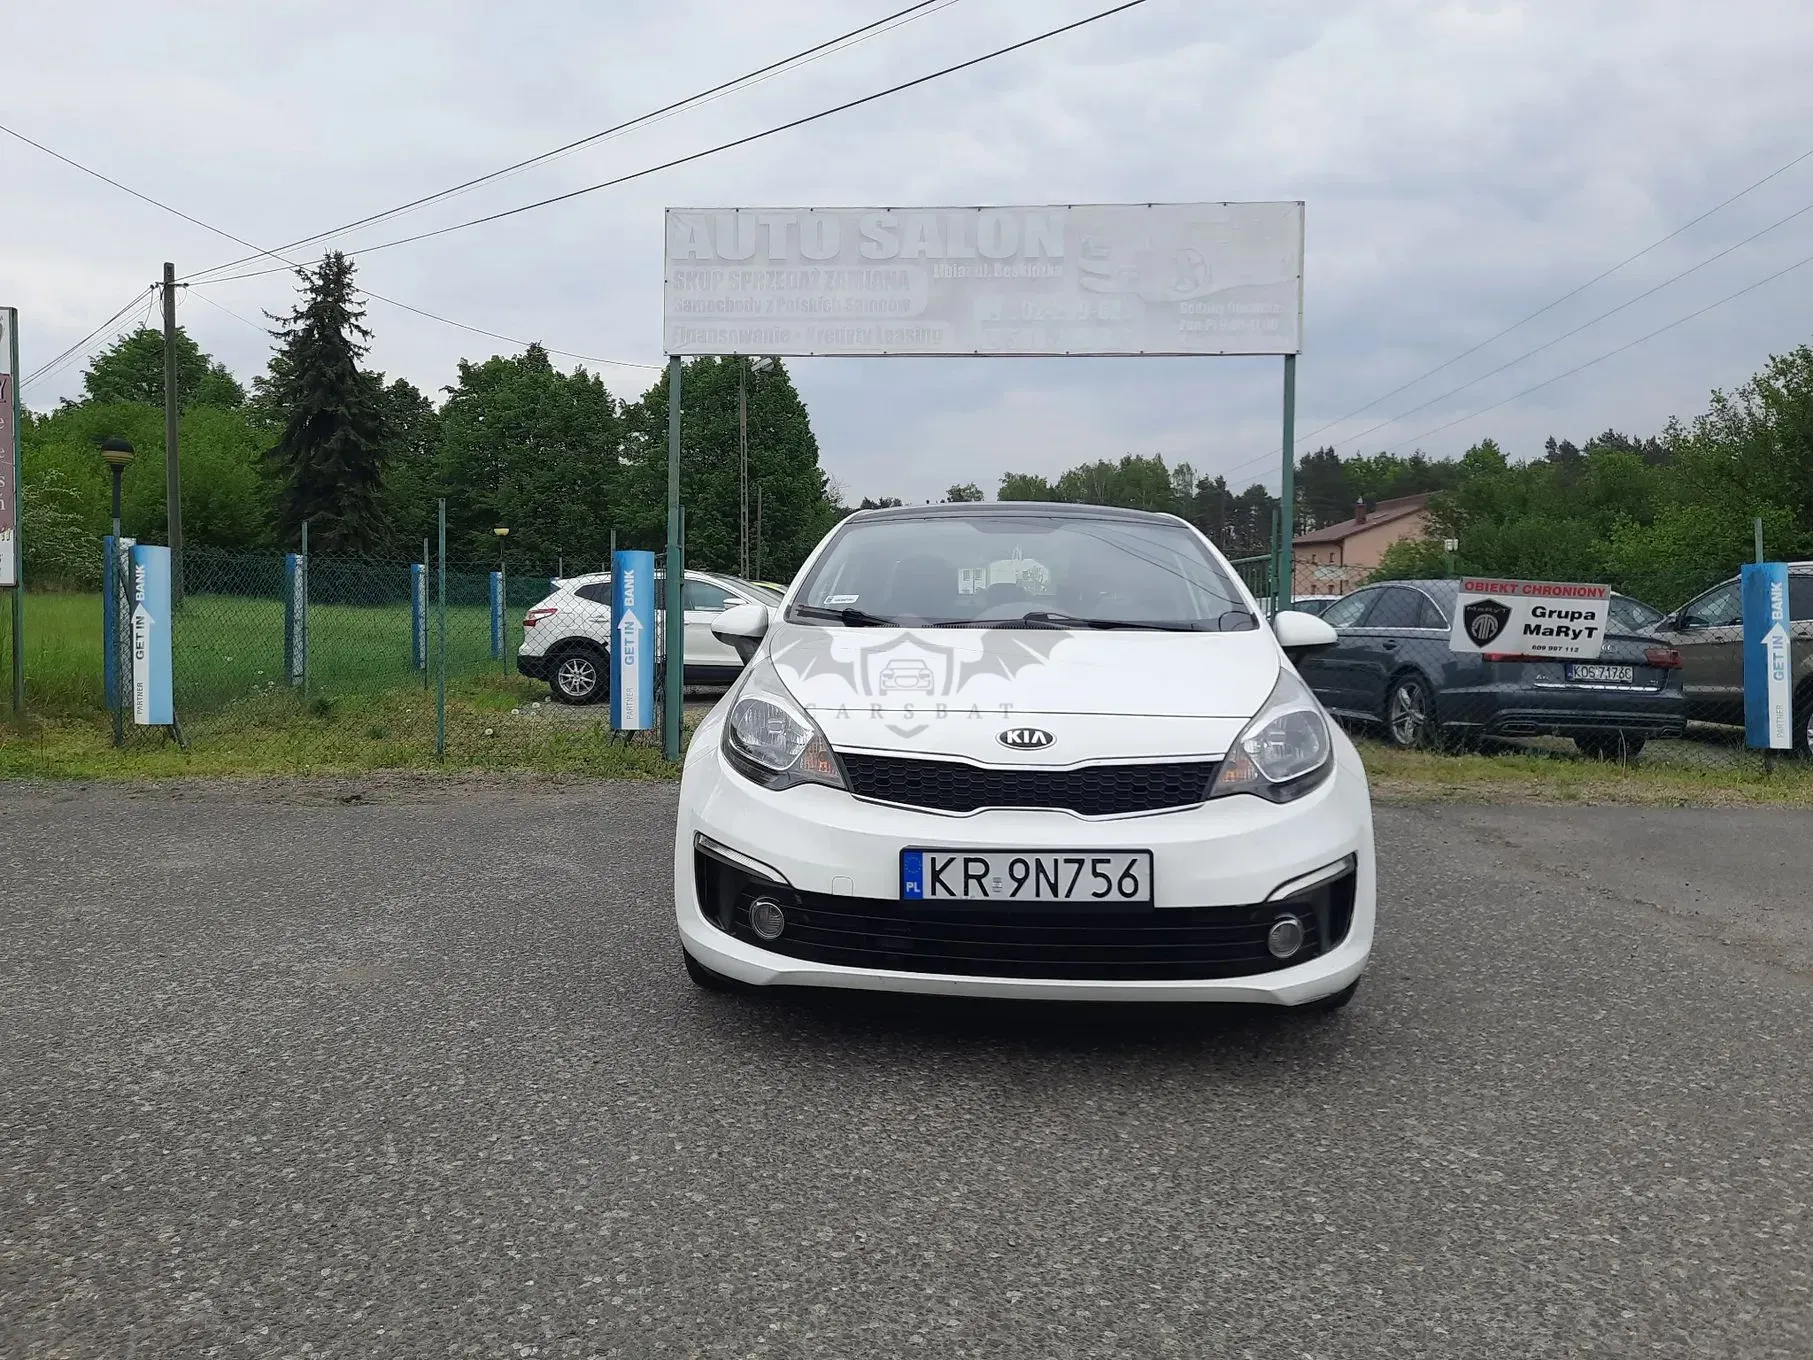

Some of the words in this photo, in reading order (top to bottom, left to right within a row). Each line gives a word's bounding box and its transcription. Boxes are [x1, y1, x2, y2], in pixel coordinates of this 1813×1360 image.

[671, 212, 841, 261] AUTO
[859, 211, 1064, 260] SALON
[673, 270, 723, 291] SKUP
[135, 564, 145, 601] BANK
[624, 569, 635, 607] BANK
[1464, 581, 1519, 594] OBIEKT
[1522, 584, 1606, 598] CHRONIONY
[1531, 605, 1596, 622] Grupa
[1771, 582, 1783, 621] BANK
[135, 616, 145, 628] IN
[624, 621, 635, 634] IN
[1523, 624, 1599, 641] MaRyT
[135, 632, 145, 660] GET
[624, 639, 635, 666] GET
[1772, 635, 1784, 650] IN
[1573, 665, 1596, 678] KOS
[1773, 653, 1784, 681] GET
[136, 682, 144, 715] PARTNER
[626, 687, 634, 720] PARTNER
[1006, 730, 1048, 744] KIA
[906, 881, 921, 893] PL
[930, 856, 990, 897] KR
[1008, 858, 1139, 898] 9N756
